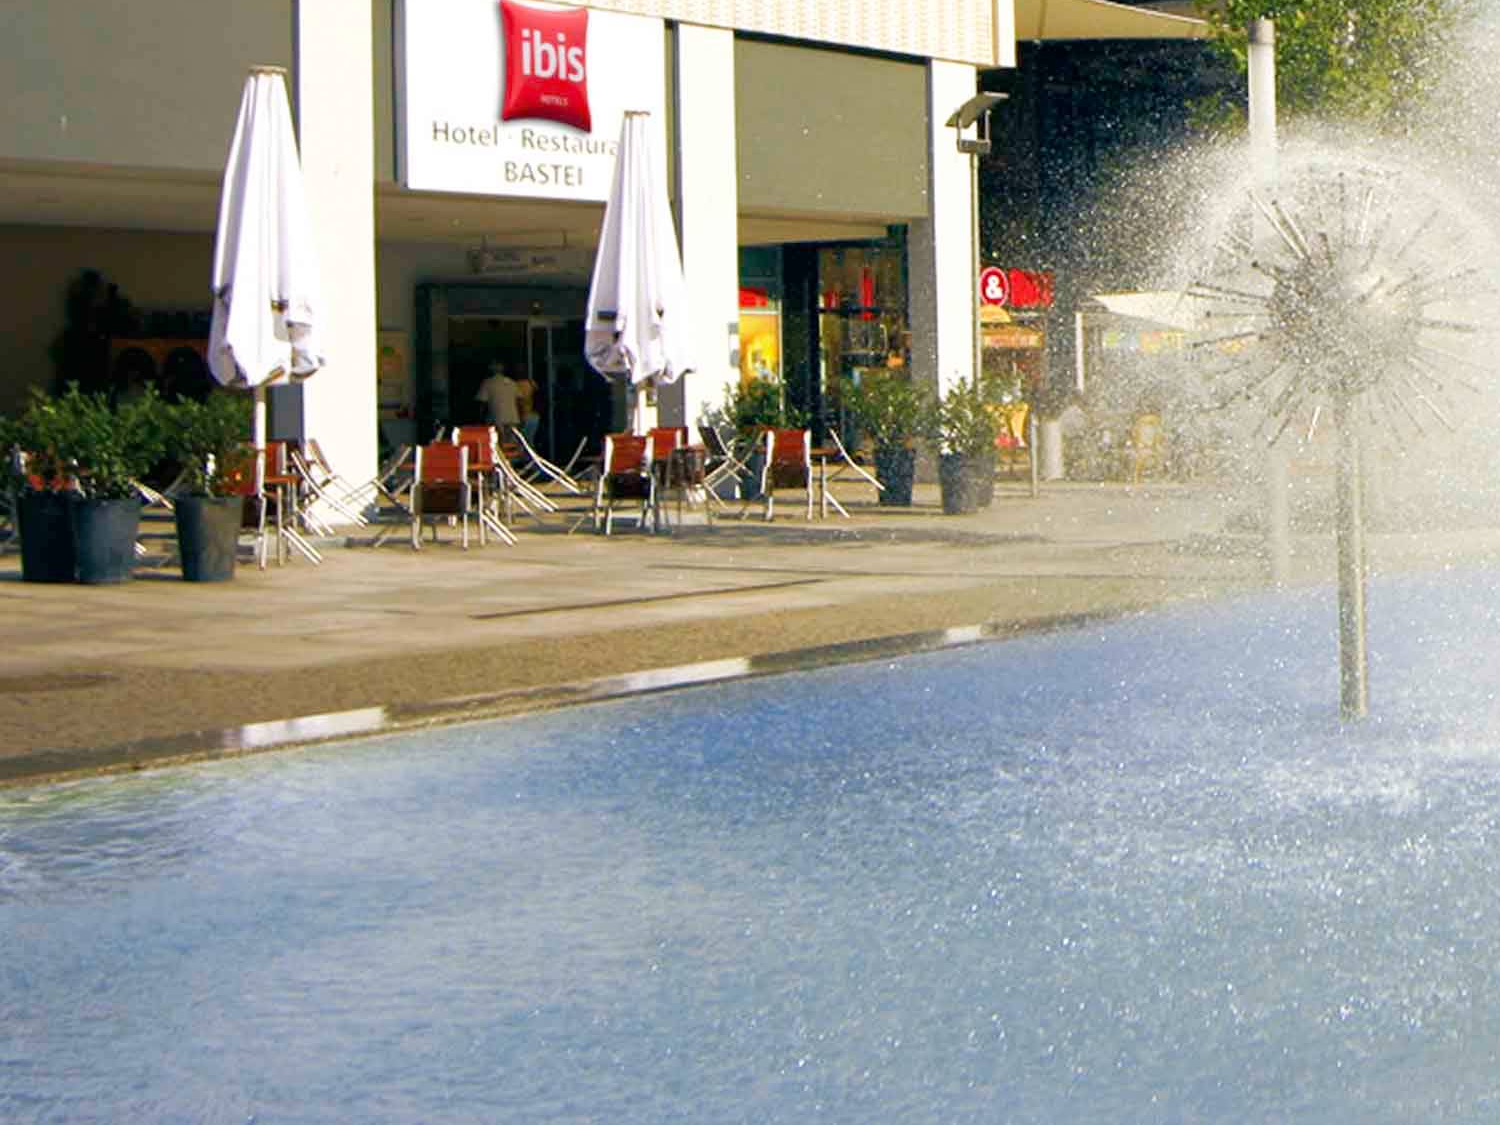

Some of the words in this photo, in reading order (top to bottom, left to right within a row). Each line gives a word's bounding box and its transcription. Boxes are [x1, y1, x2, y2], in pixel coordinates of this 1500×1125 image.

[520, 28, 585, 83] ibis
[432, 121, 499, 146] Hotel
[520, 128, 621, 156] Restaura
[504, 161, 583, 186] BASTEI
